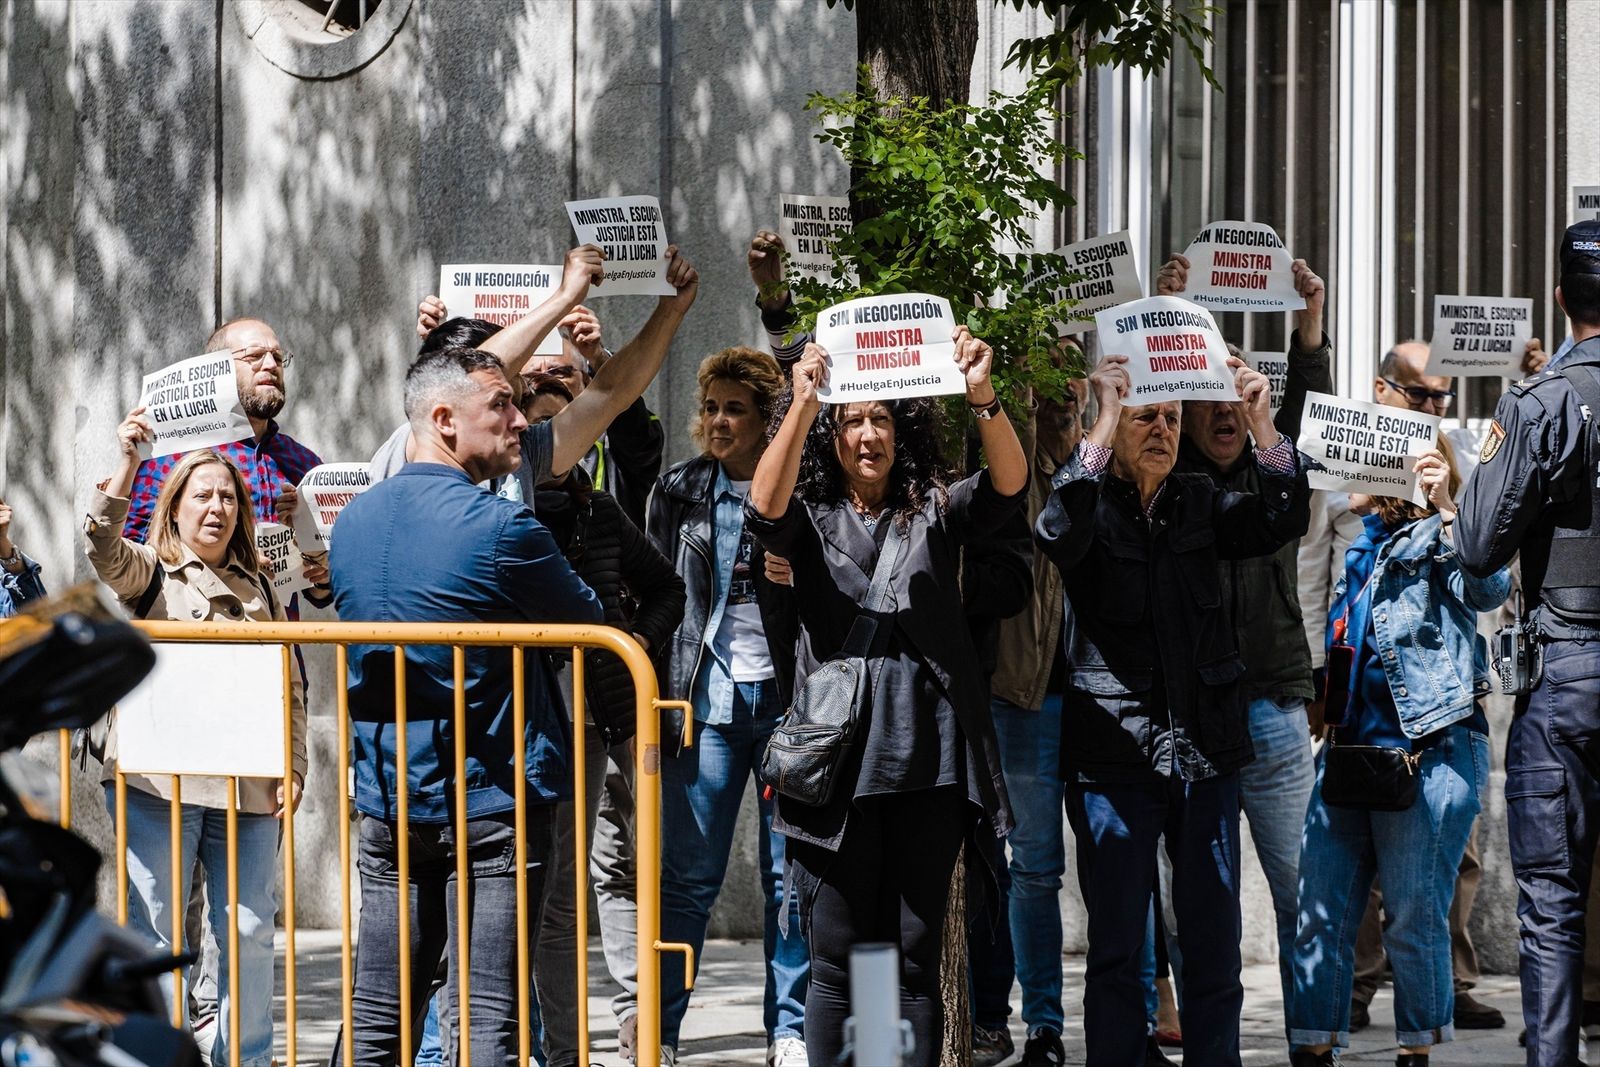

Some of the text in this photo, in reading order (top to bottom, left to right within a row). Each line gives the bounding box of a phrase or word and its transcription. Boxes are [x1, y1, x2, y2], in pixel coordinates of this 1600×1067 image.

[574, 208, 629, 225] MINISTRA,
[783, 203, 826, 222] MINISTRA,
[596, 222, 658, 242] JUSTICIA ESTÁ
[792, 222, 832, 237] JUSTICIA
[603, 244, 657, 261] EN LA LUCHA
[798, 239, 810, 253] EN
[812, 240, 824, 254] LA
[1074, 241, 1128, 265] ESCUCHA
[1213, 251, 1272, 270] MINISTRA
[453, 270, 550, 288] SIN NEGOCIACIÓN
[1211, 271, 1268, 290] DIMISIÓN
[1076, 280, 1114, 301] LUCHA
[474, 294, 529, 309] MINISTRA
[1193, 295, 1284, 306] #HuelgaEnJusticia
[829, 299, 943, 327] SIN NEGOCIACIÓN
[1115, 314, 1138, 334] SIN
[1140, 310, 1213, 332] NEGOCIACIÓN
[1440, 304, 1527, 321] MINISTRA, ESCUCHA
[855, 327, 923, 349] MINISTRA
[1450, 321, 1515, 337] JUSTICIA ESTÁ
[1145, 333, 1207, 353] MINISTRA
[1453, 337, 1513, 353] EN LA LUCHA
[856, 347, 921, 372] DIMISIÓN
[1149, 351, 1207, 373] DIMISIÓN
[188, 359, 231, 382] ESCUCHA
[148, 377, 217, 407] JUSTICIA ESTÁ
[840, 374, 942, 392] #HuelgaEnJusticia
[1136, 379, 1225, 395] #HuelgaEnJusticia
[153, 398, 218, 423] EN LA LUCHA
[1308, 402, 1432, 441] MINISTRA, ESCUCHA
[1320, 424, 1410, 455] JUSTICIA ESTÁ
[1325, 444, 1405, 471] EN LA LUCHA
[313, 492, 357, 508] MINIST
